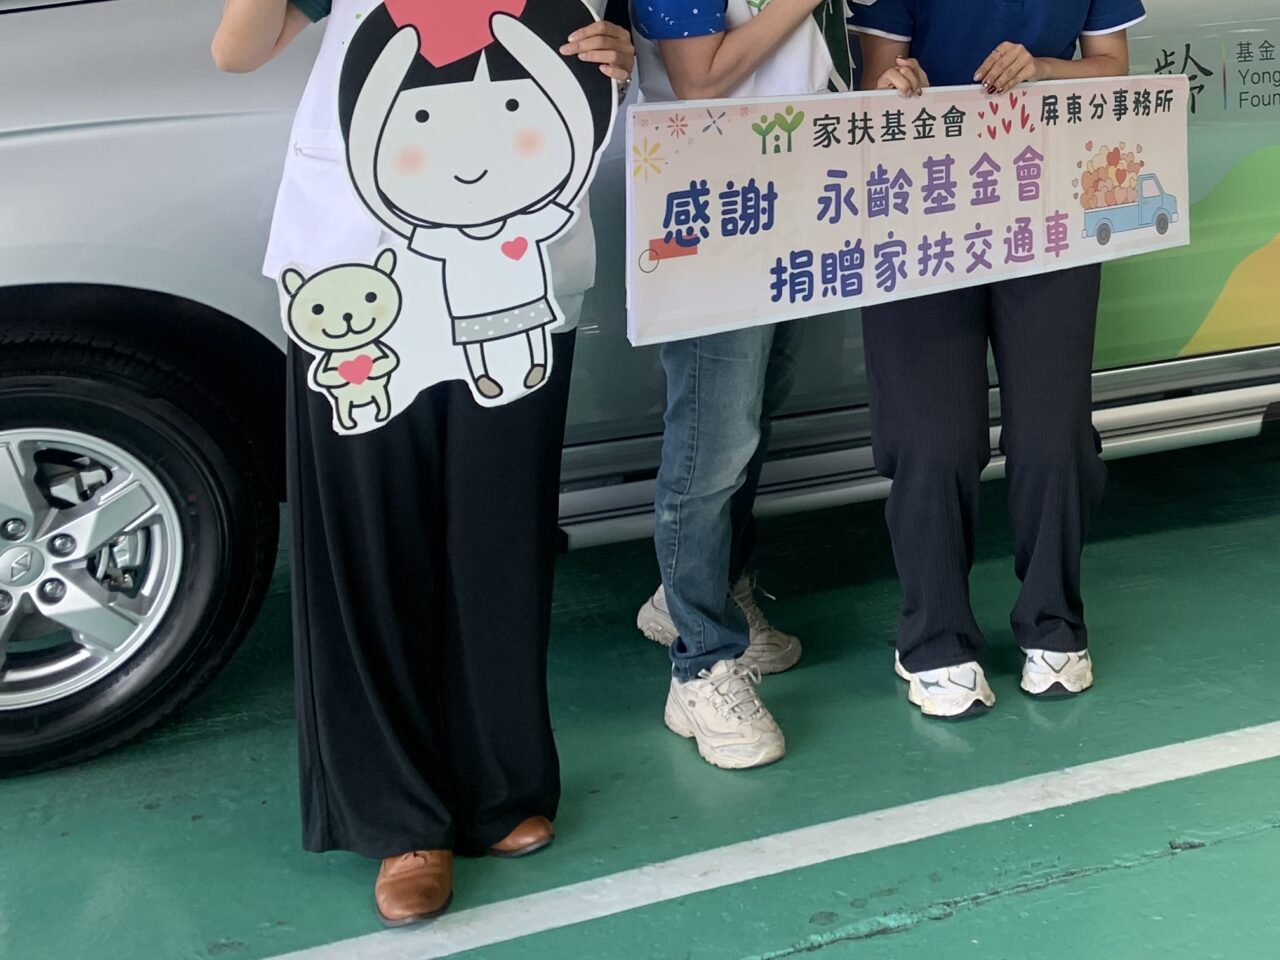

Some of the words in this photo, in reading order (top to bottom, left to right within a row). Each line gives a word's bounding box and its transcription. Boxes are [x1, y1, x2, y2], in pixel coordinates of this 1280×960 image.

[813, 106, 967, 149] 家扶基金會
[1040, 88, 1174, 128] 屏東分事務所
[662, 178, 778, 247] 感謝
[816, 145, 1045, 225] 永齡基金會
[769, 209, 1071, 305] 捐贈家扶交通車
